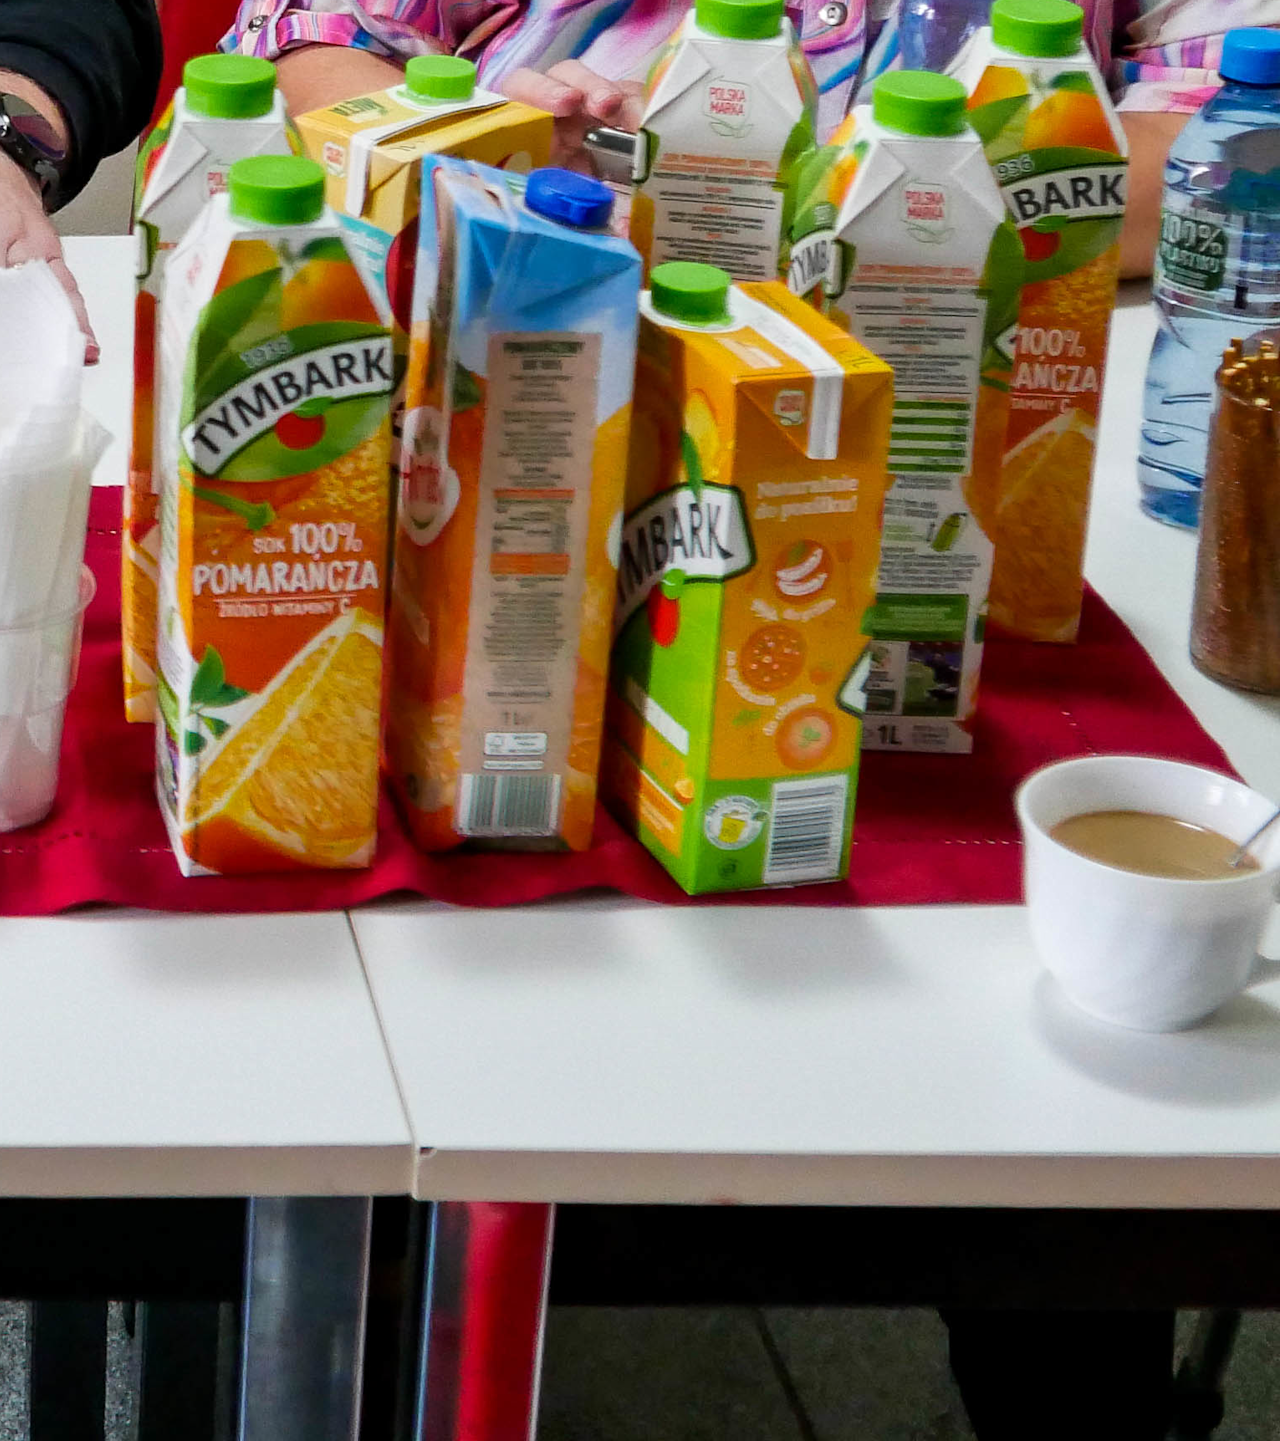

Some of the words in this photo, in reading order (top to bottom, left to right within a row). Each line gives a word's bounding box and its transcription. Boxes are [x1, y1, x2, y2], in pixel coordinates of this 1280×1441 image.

[709, 87, 747, 103] POLSKA
[710, 101, 744, 116] MARKA
[1011, 173, 1126, 222] BARK
[1019, 327, 1087, 357] 100%
[192, 346, 391, 455] TYMBARK
[252, 536, 285, 554] SOK
[289, 522, 363, 554] 100%
[192, 553, 380, 596] POMARAŃCZA
